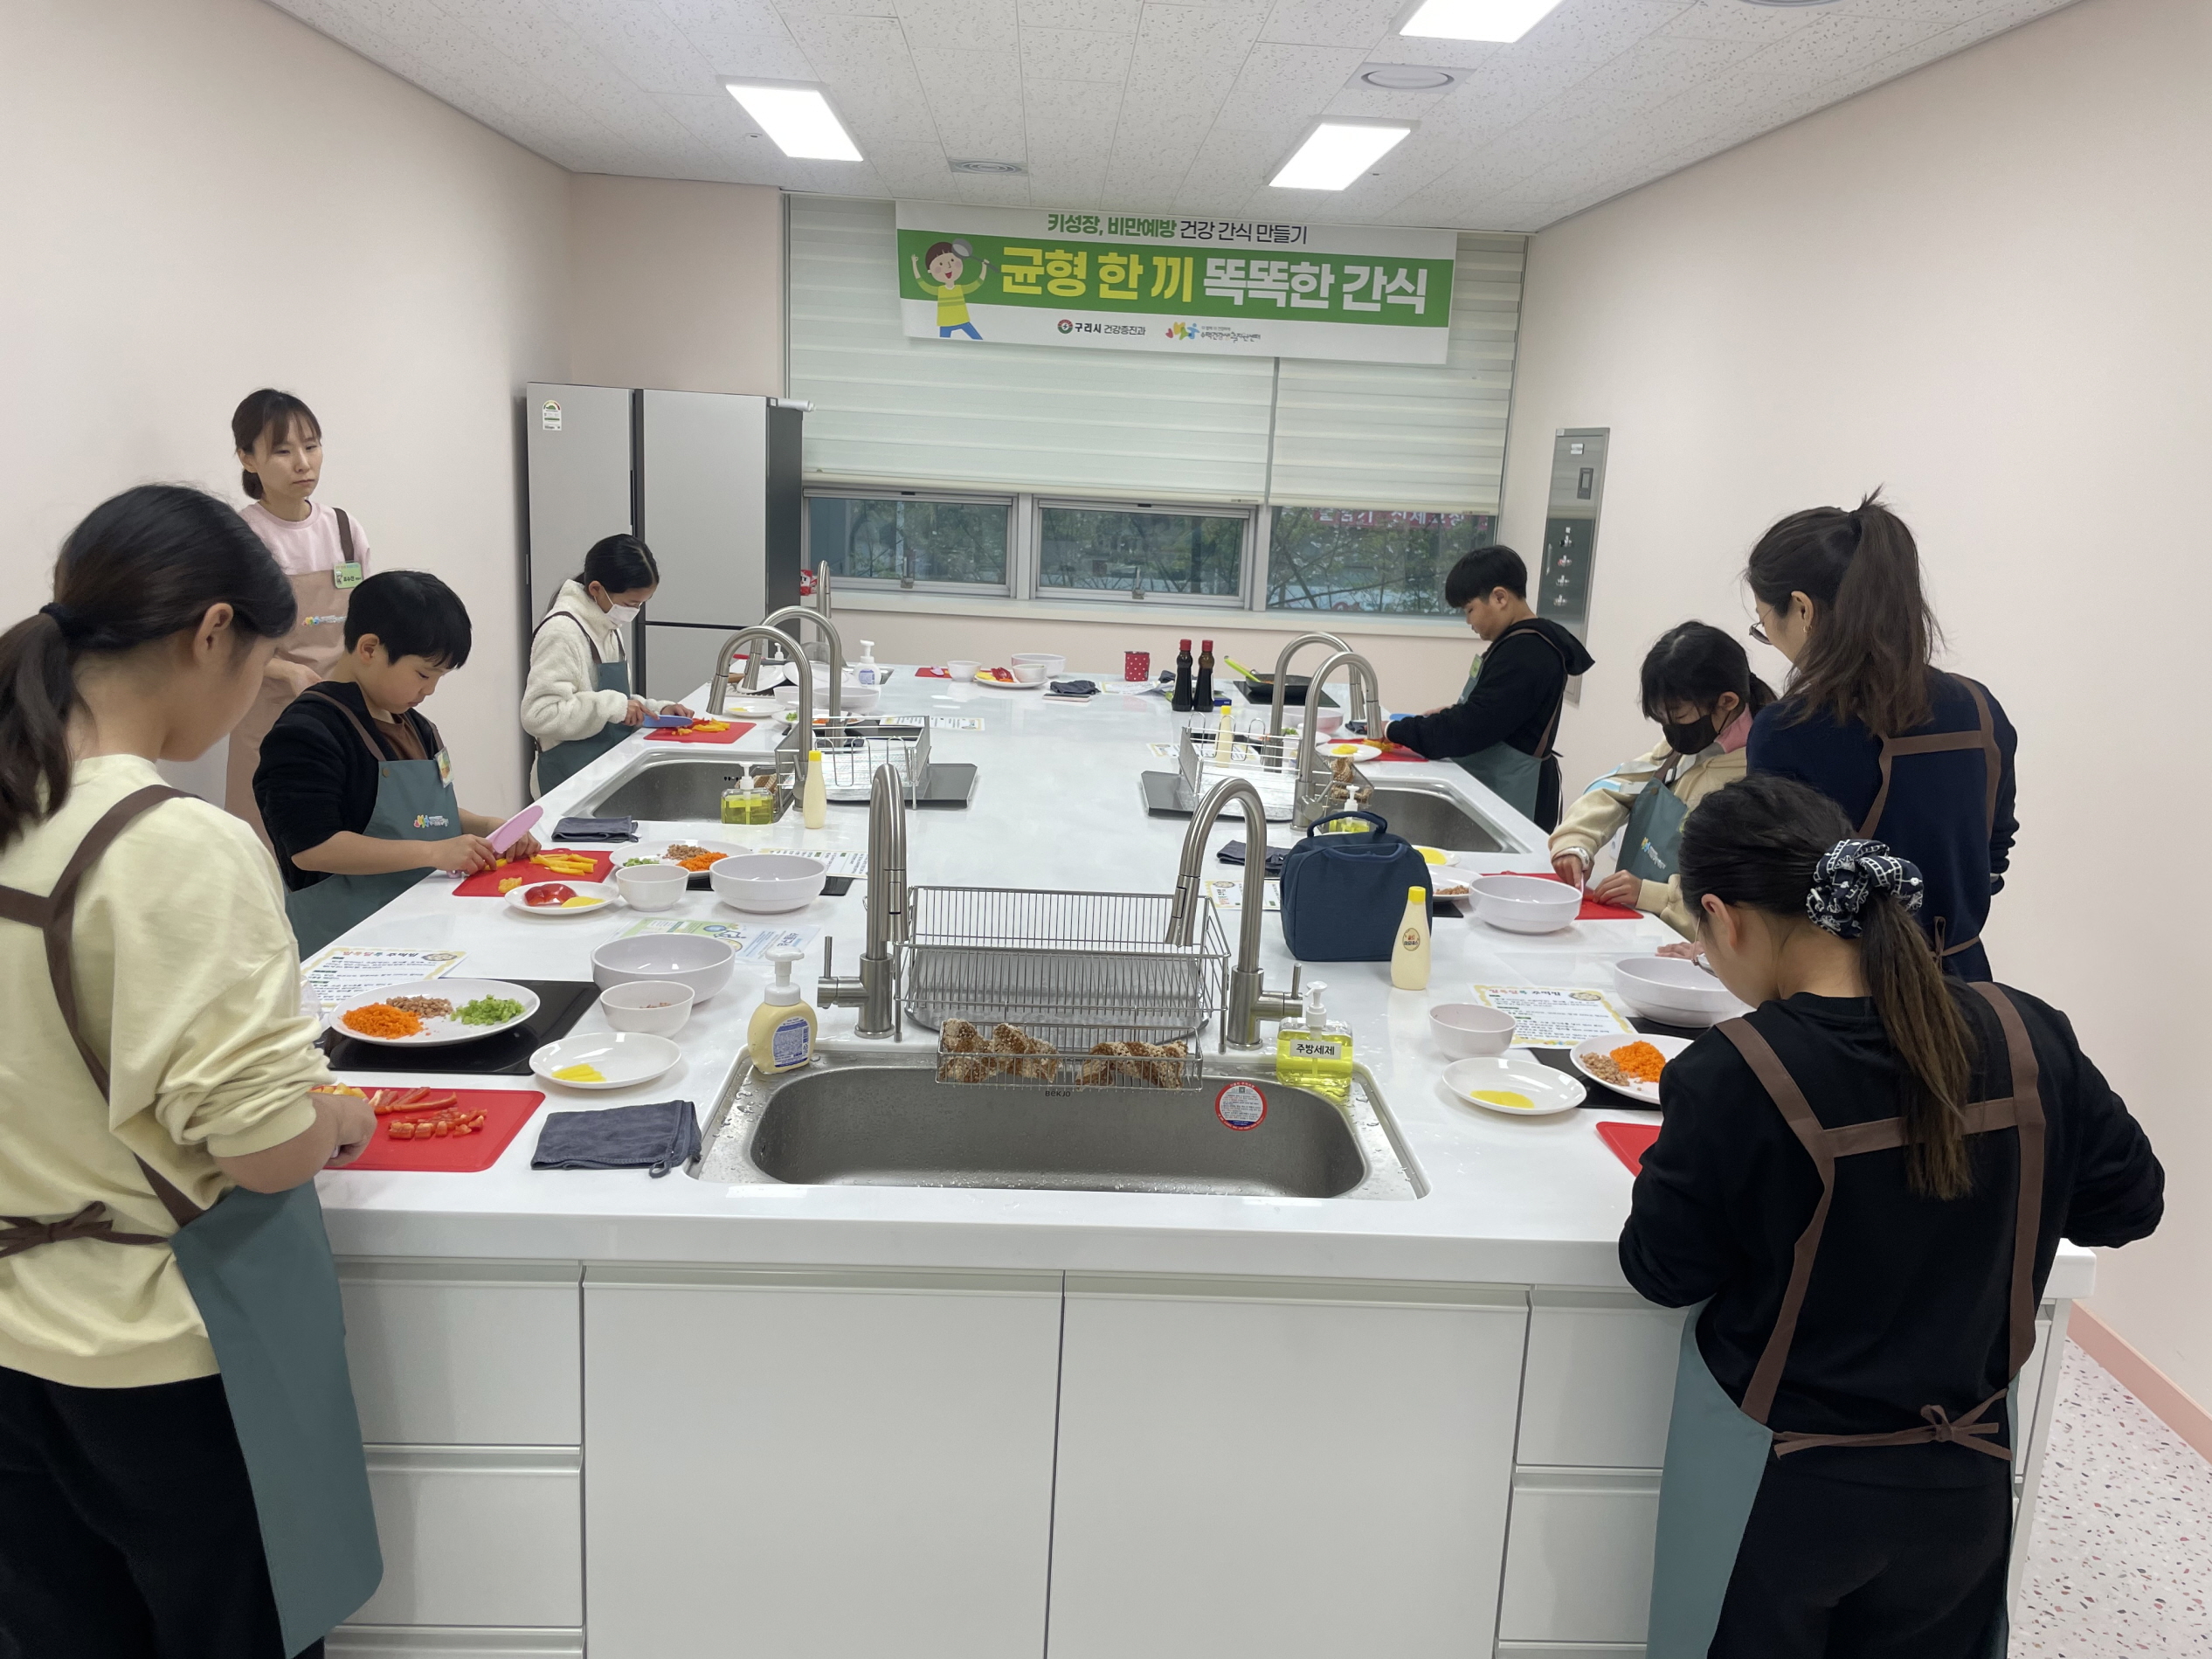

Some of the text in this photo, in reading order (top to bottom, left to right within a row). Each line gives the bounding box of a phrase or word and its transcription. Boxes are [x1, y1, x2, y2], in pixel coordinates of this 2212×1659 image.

[1047, 213, 1308, 245] 키성장, 비만예방 건강 간식 만들기
[1001, 246, 1428, 315] 균형 한 끼 똑똑한 간식
[1075, 322, 1146, 335] 구리시 건강증진과
[1296, 1043, 1335, 1056] 주방세제
